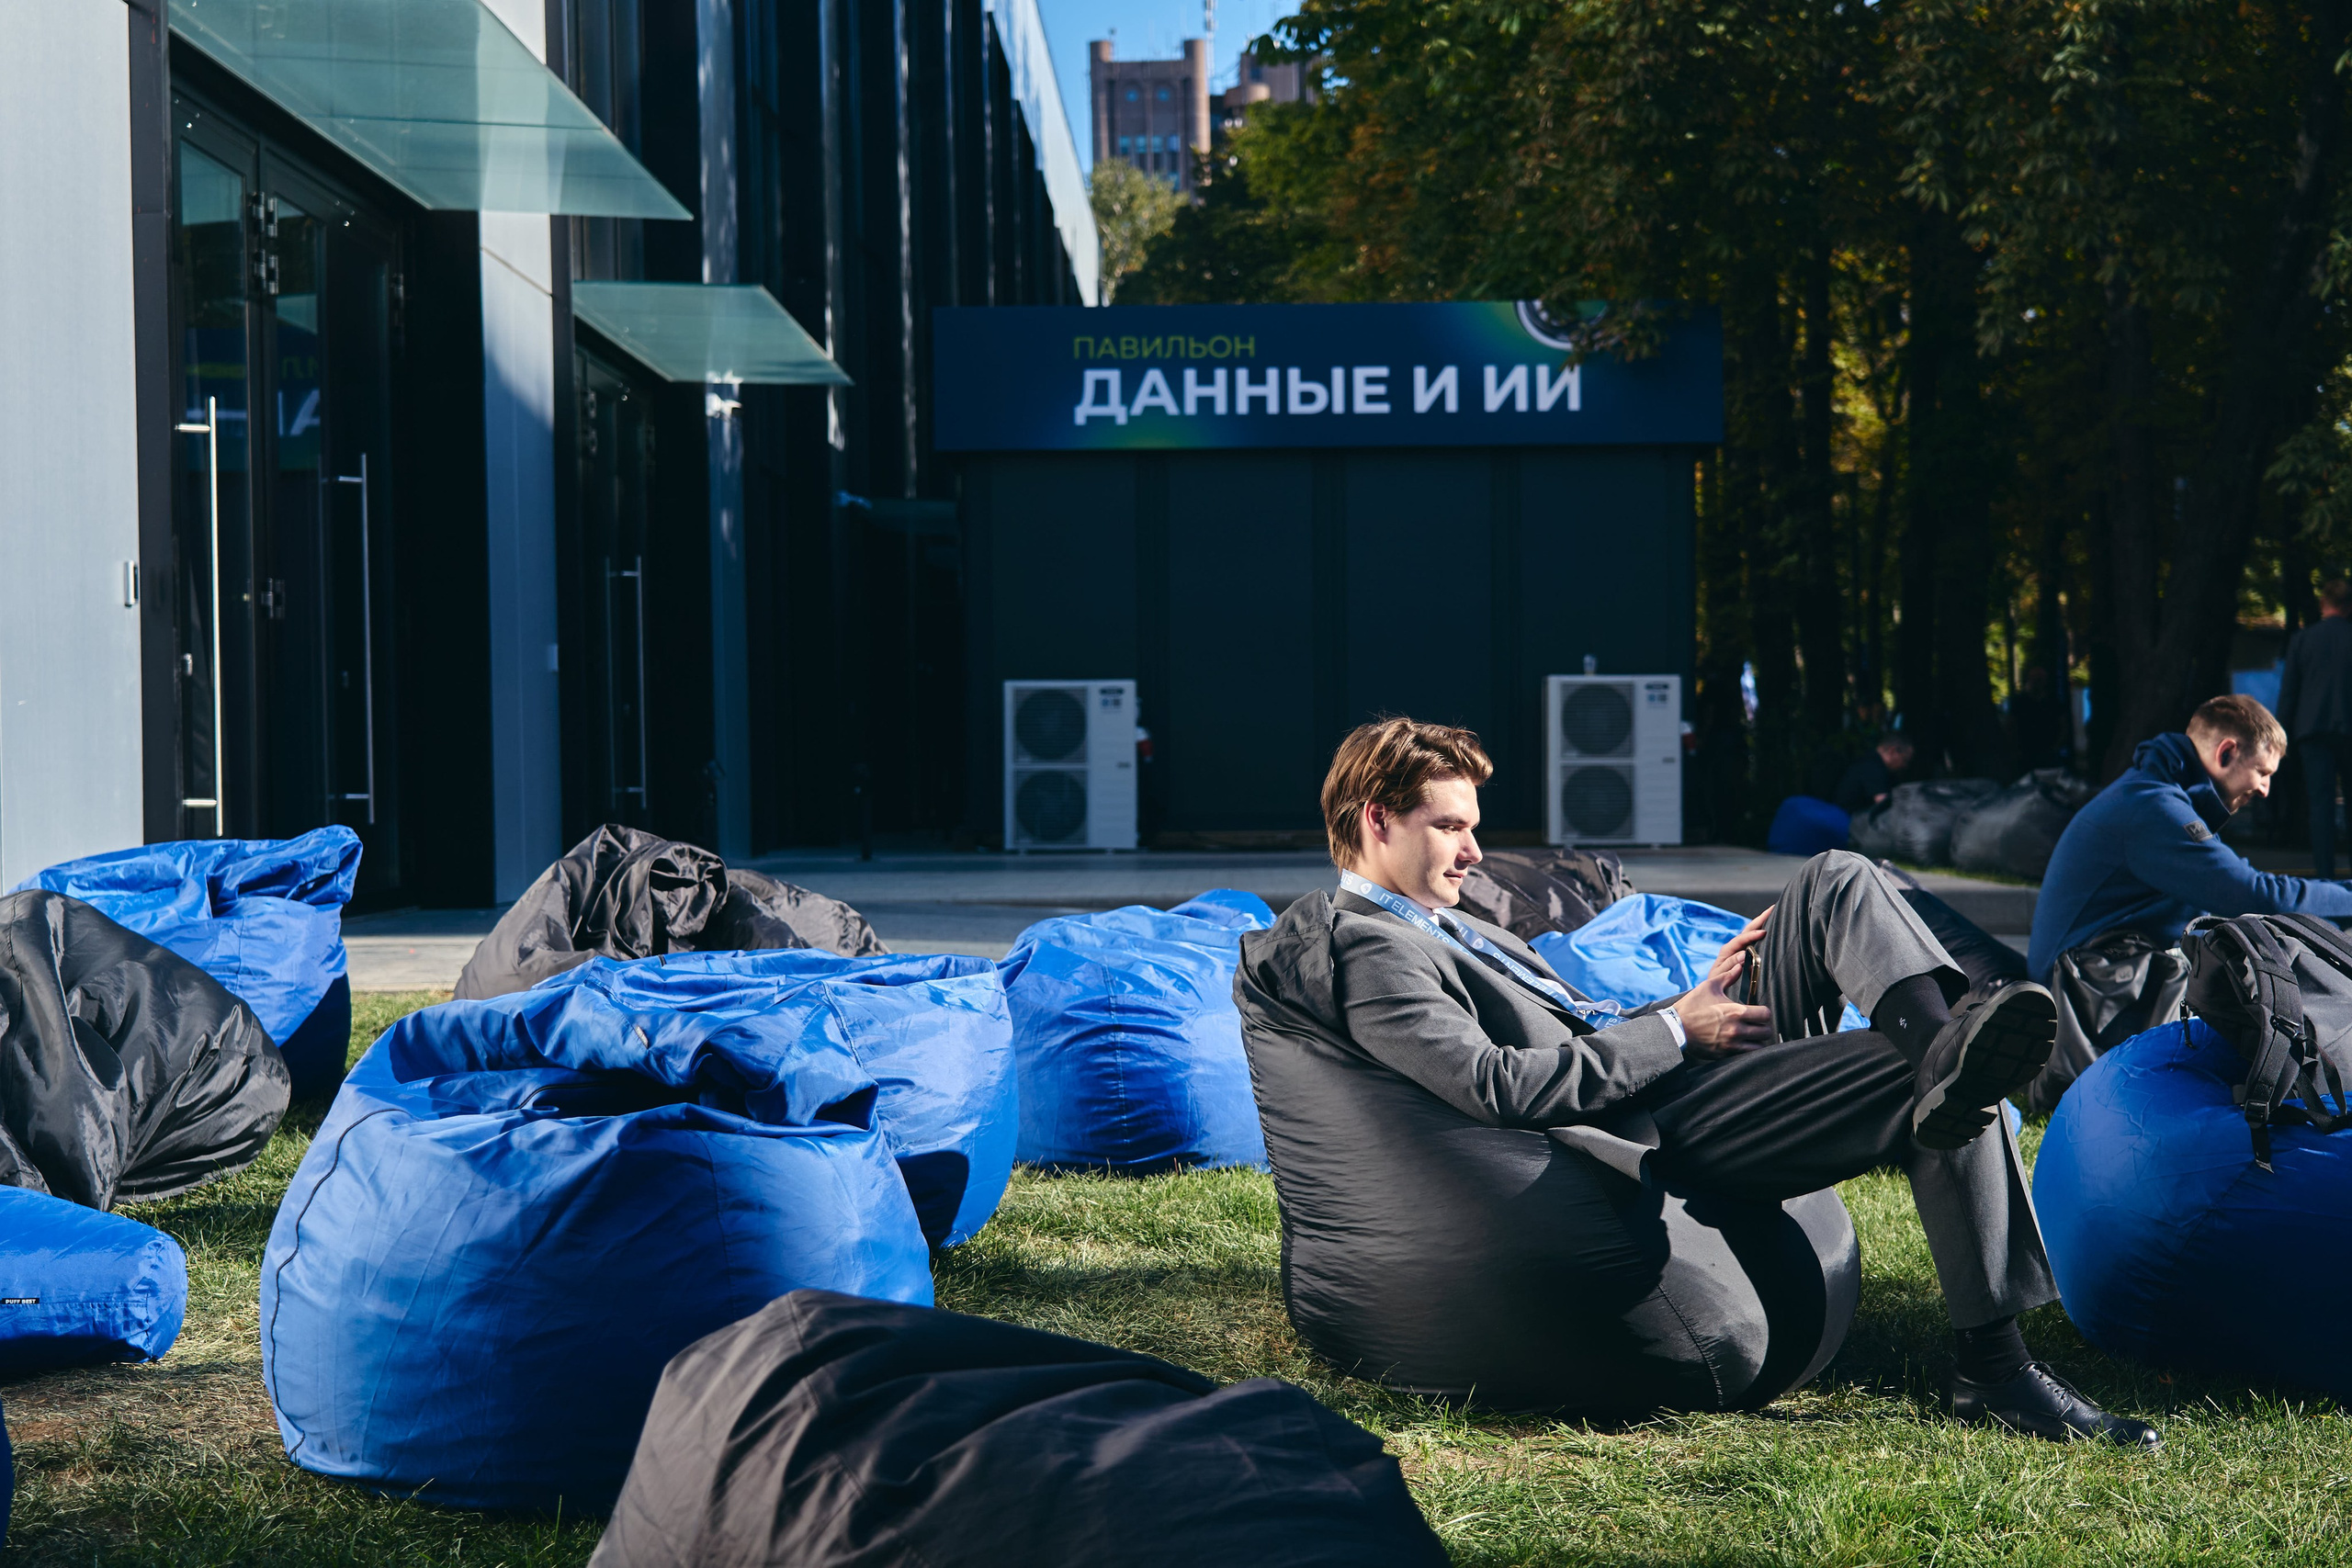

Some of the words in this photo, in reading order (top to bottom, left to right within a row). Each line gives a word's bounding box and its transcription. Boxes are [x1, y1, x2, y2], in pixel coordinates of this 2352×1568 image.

[1073, 335, 1256, 359] ПАВИЛЬОН
[1075, 367, 1391, 425] ДАННЫЕ
[1413, 365, 1459, 414] И
[1483, 363, 1582, 413] ИИ
[1379, 892, 1393, 905] IT
